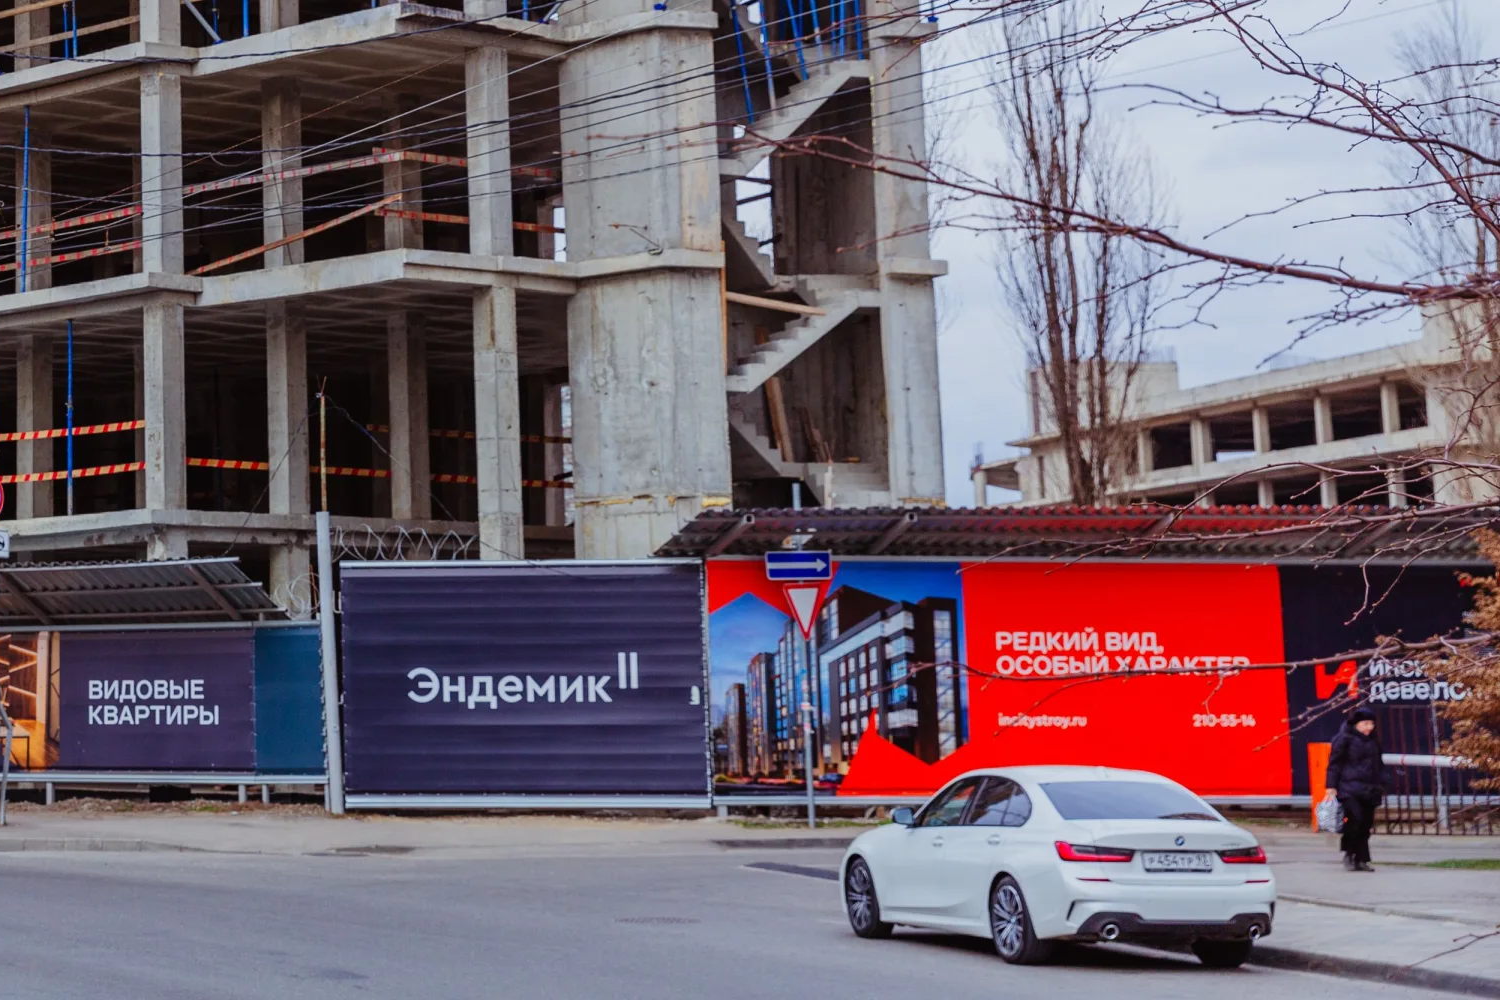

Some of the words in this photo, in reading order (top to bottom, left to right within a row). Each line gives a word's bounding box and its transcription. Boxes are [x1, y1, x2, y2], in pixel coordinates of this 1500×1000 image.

[995, 627, 1099, 654] РЕДКИЙ
[1105, 632, 1164, 655] ВИД,
[996, 652, 1109, 676] ОСОБЫЙ
[88, 679, 205, 703] ВИДОВЫЕ
[407, 667, 613, 709] Эндемик
[88, 704, 220, 726] КВАРТИРЫ
